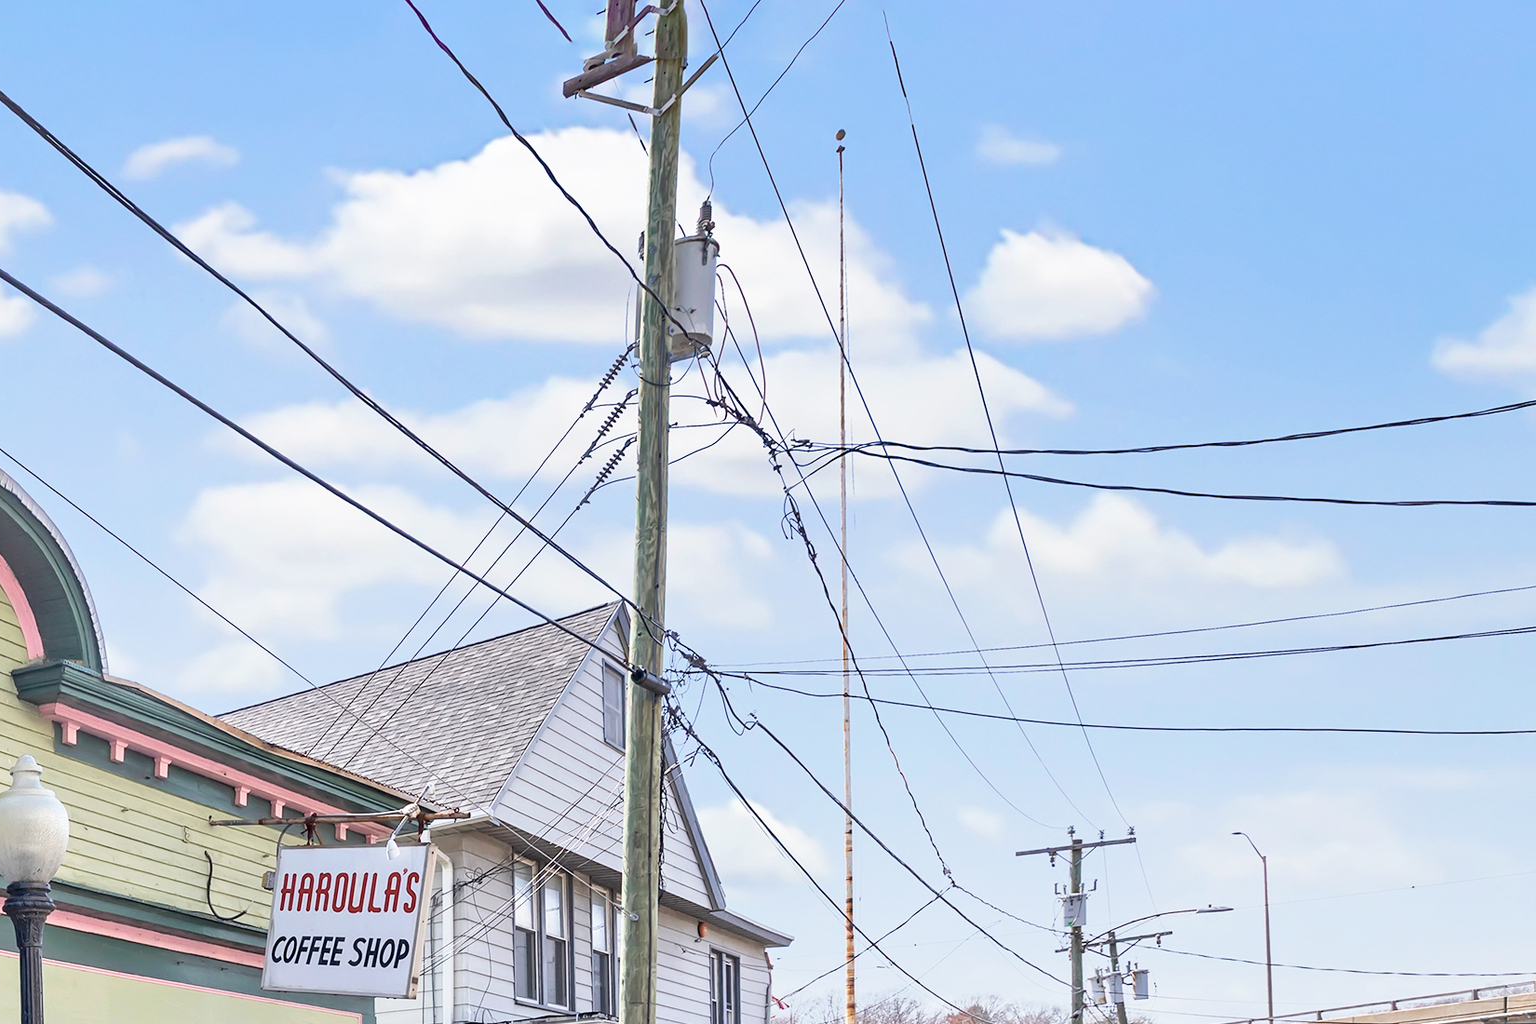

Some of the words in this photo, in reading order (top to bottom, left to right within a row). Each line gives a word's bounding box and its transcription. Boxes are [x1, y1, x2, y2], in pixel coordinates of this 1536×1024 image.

[279, 868, 420, 914] HAROULA'S
[271, 935, 346, 966] COFFEE
[348, 937, 410, 969] SHOP
